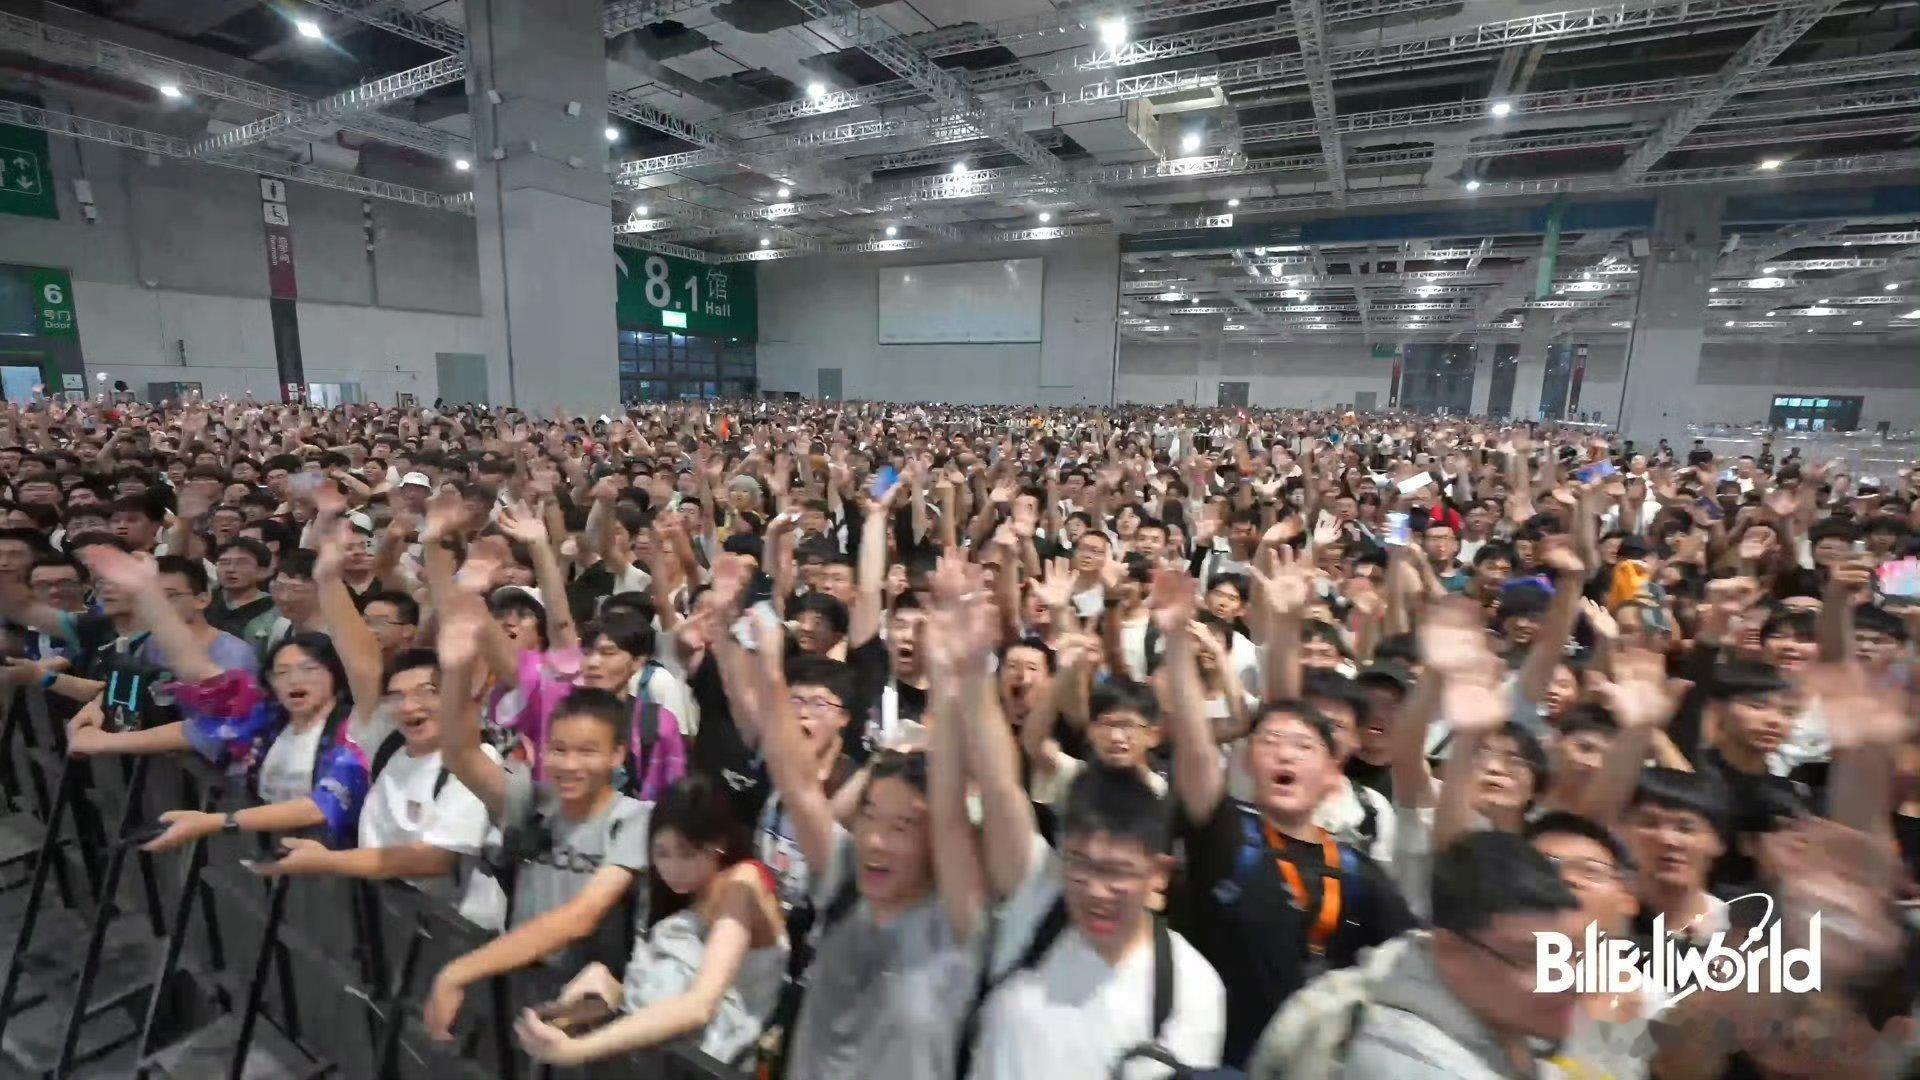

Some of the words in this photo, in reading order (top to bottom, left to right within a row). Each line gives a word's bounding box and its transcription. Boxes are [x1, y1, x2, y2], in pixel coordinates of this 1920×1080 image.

[645, 256, 698, 312] 8.1
[43, 283, 63, 304] 6
[705, 301, 731, 317] Hall
[44, 320, 71, 329] Door
